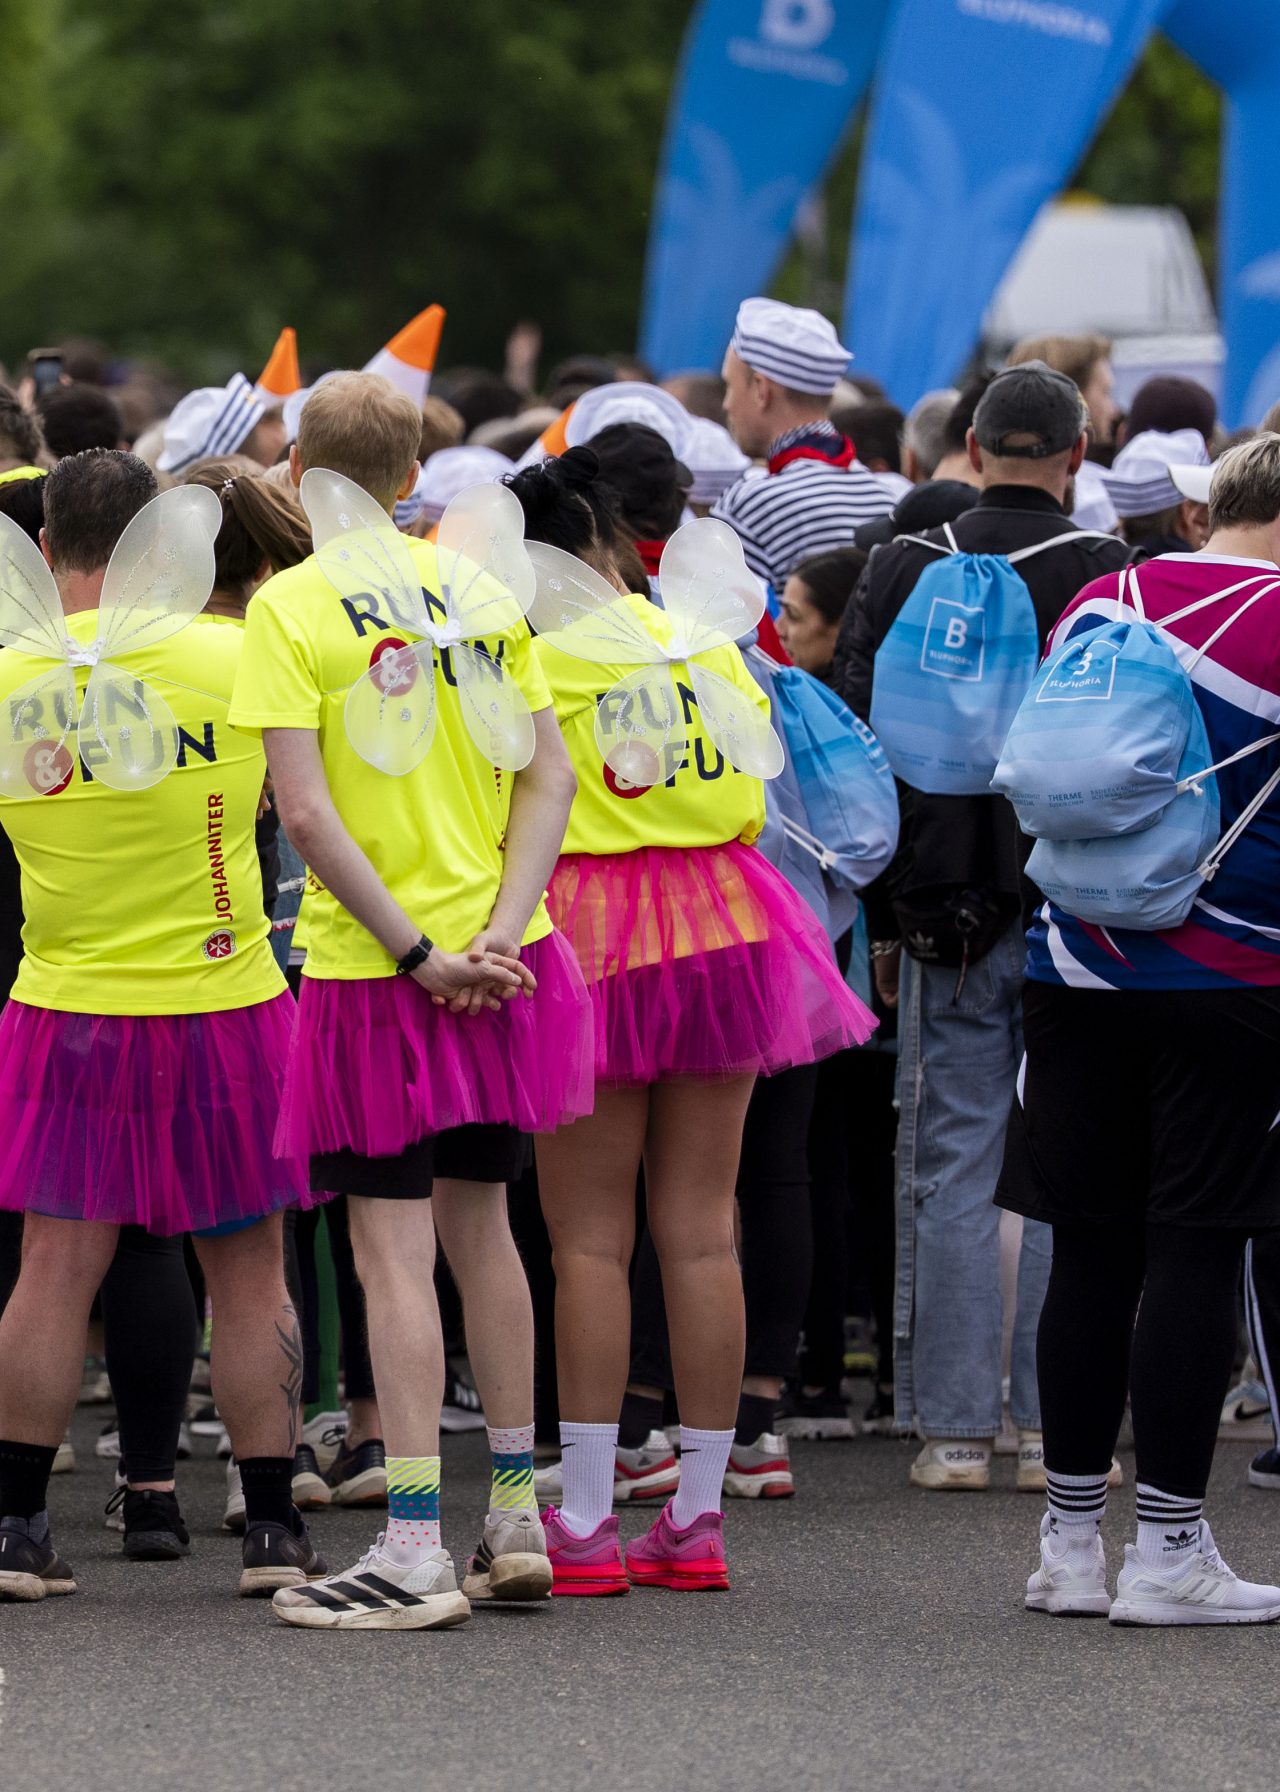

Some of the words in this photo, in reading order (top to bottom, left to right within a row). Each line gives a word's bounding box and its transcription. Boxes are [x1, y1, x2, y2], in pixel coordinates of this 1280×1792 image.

[944, 617, 968, 648] B
[10, 680, 145, 741] RUN
[79, 722, 218, 783] FUN
[1048, 792, 1083, 802] THERME
[207, 793, 234, 921] JOHANNITER
[1075, 888, 1109, 896] THERME
[945, 1449, 985, 1460] adidas
